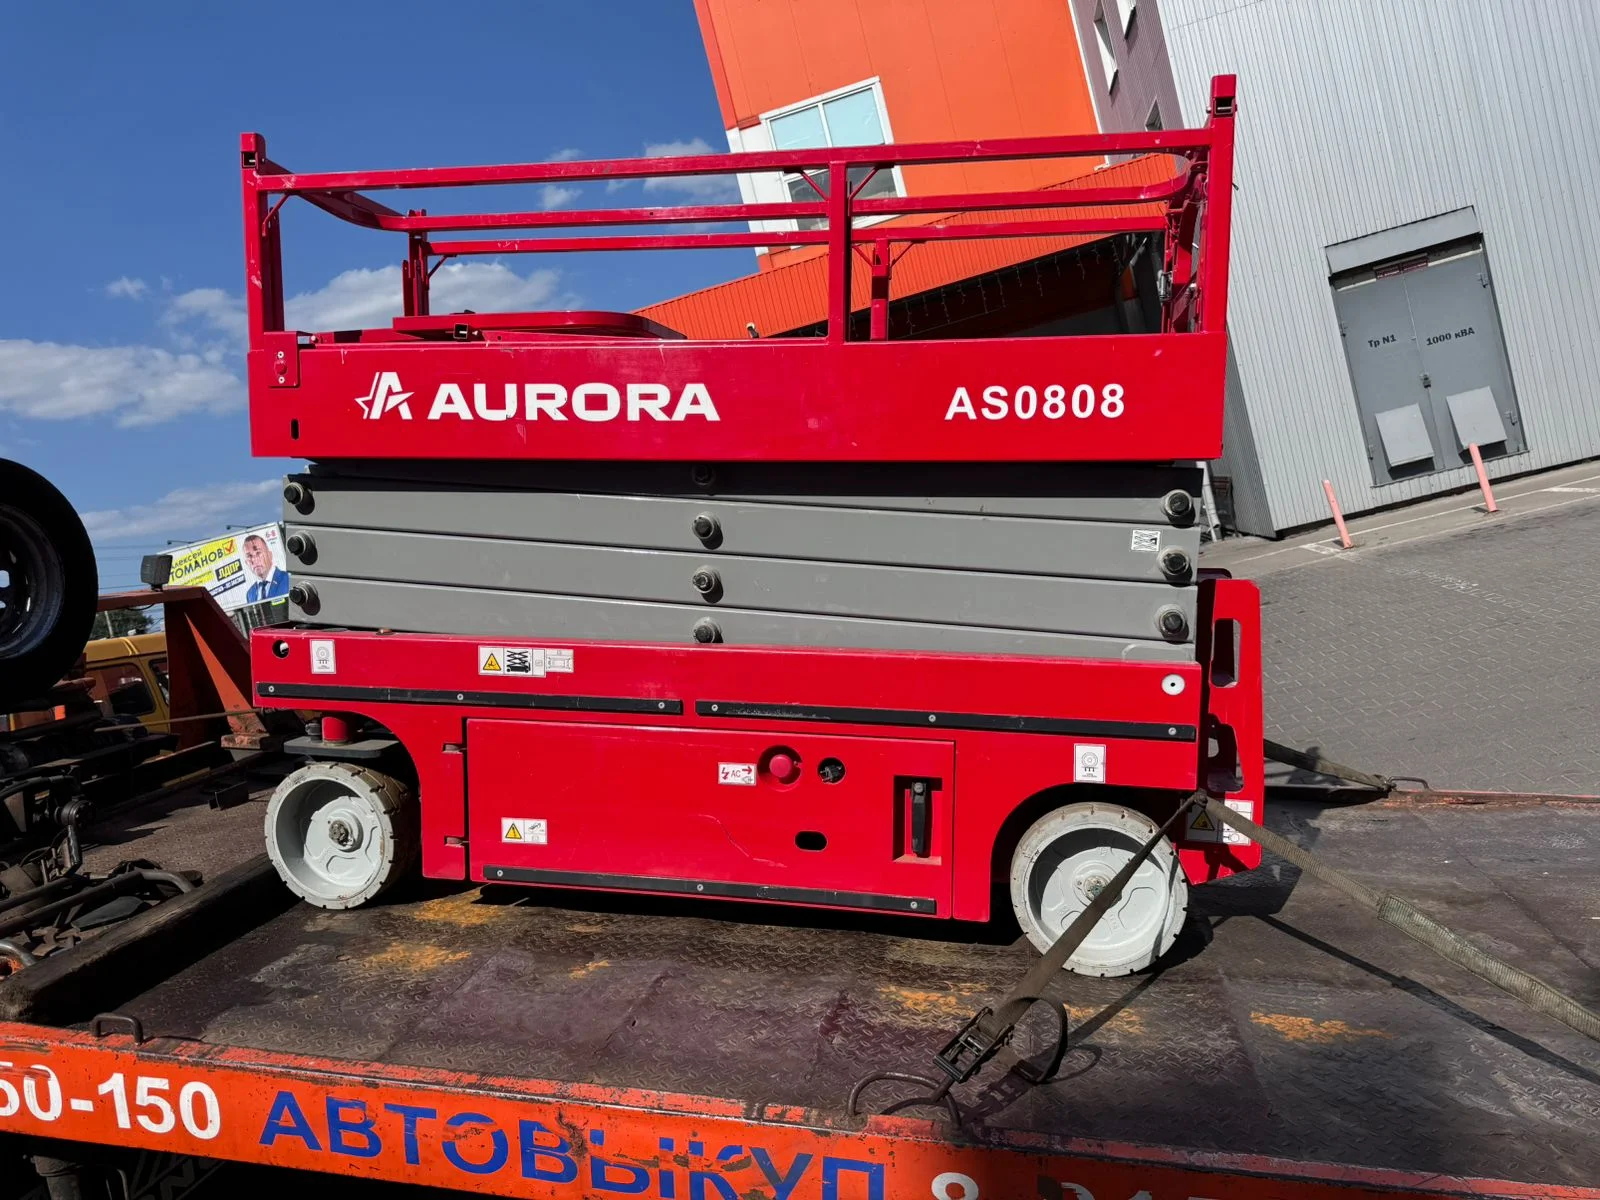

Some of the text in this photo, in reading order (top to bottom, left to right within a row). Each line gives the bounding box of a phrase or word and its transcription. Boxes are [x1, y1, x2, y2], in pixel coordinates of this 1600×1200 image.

[1426, 327, 1475, 346] 1000 кВА
[427, 382, 721, 422] AURORA
[945, 383, 1125, 420] AS0808
[218, 561, 240, 579] ЛДПР
[731, 769, 741, 778] AC
[259, 1090, 885, 1200] АВТОВЫКУП
